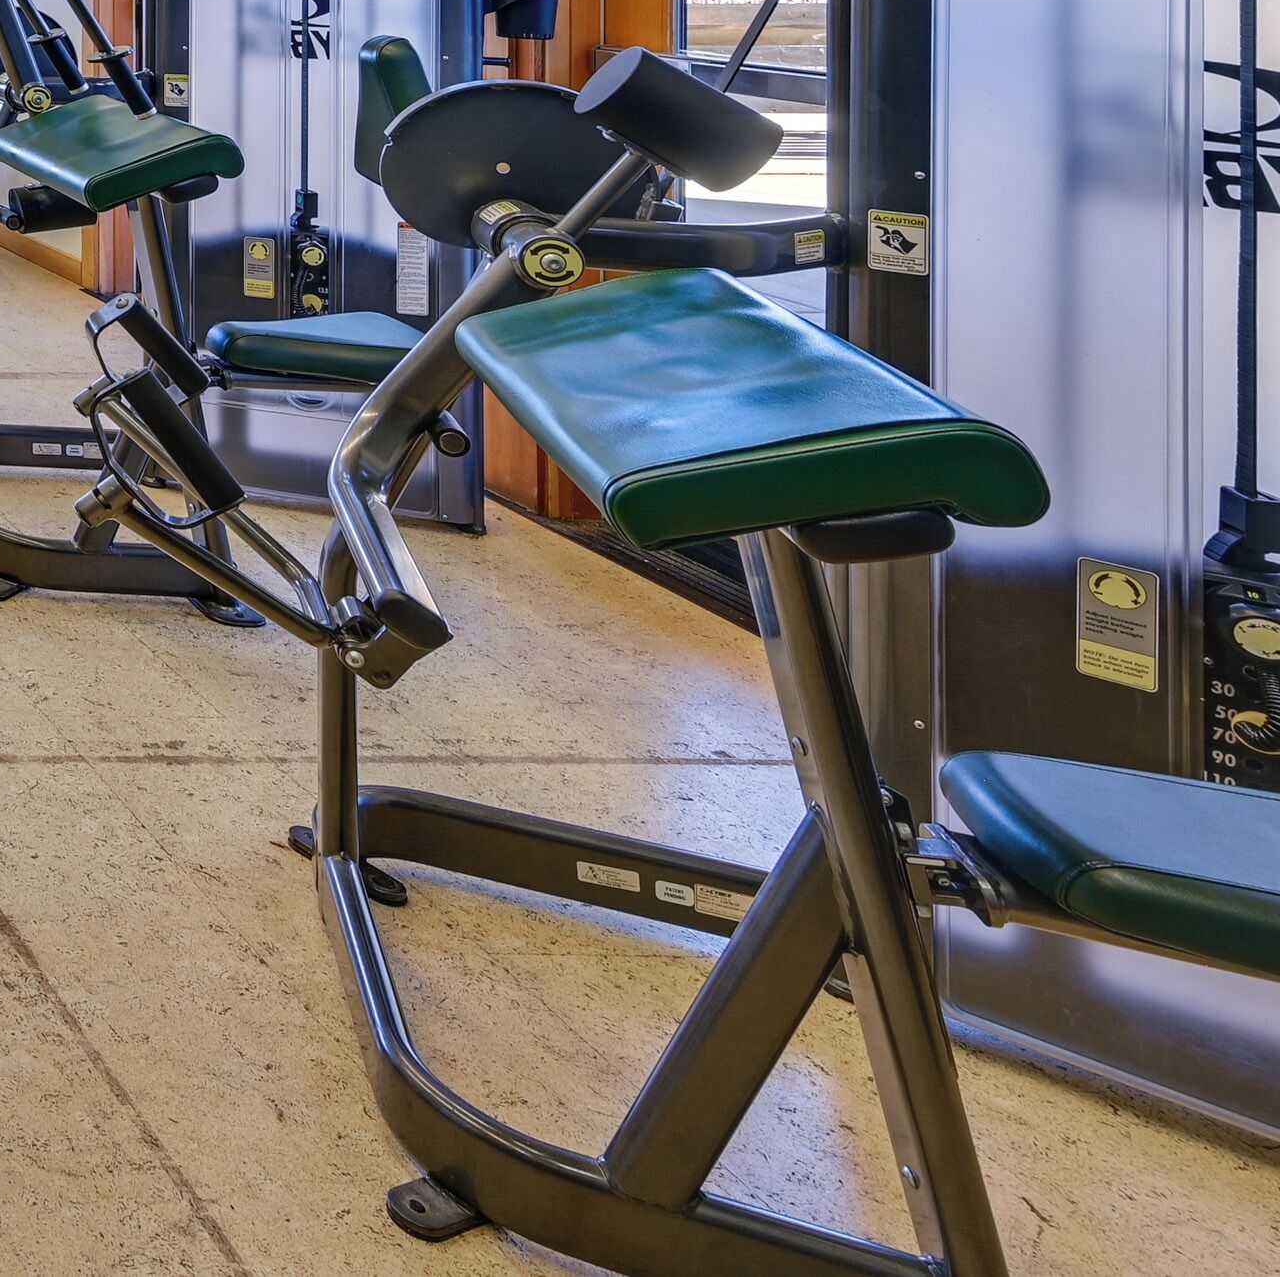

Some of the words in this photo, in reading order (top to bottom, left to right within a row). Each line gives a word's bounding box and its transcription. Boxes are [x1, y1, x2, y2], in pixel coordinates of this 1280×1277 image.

[882, 216, 924, 226] CAUTION
[1247, 590, 1260, 599] 10
[1211, 681, 1235, 697] 30
[1213, 727, 1237, 744] 70
[1212, 750, 1237, 767] 90
[665, 886, 685, 895] PATENT
[663, 892, 687, 902] PENDING
